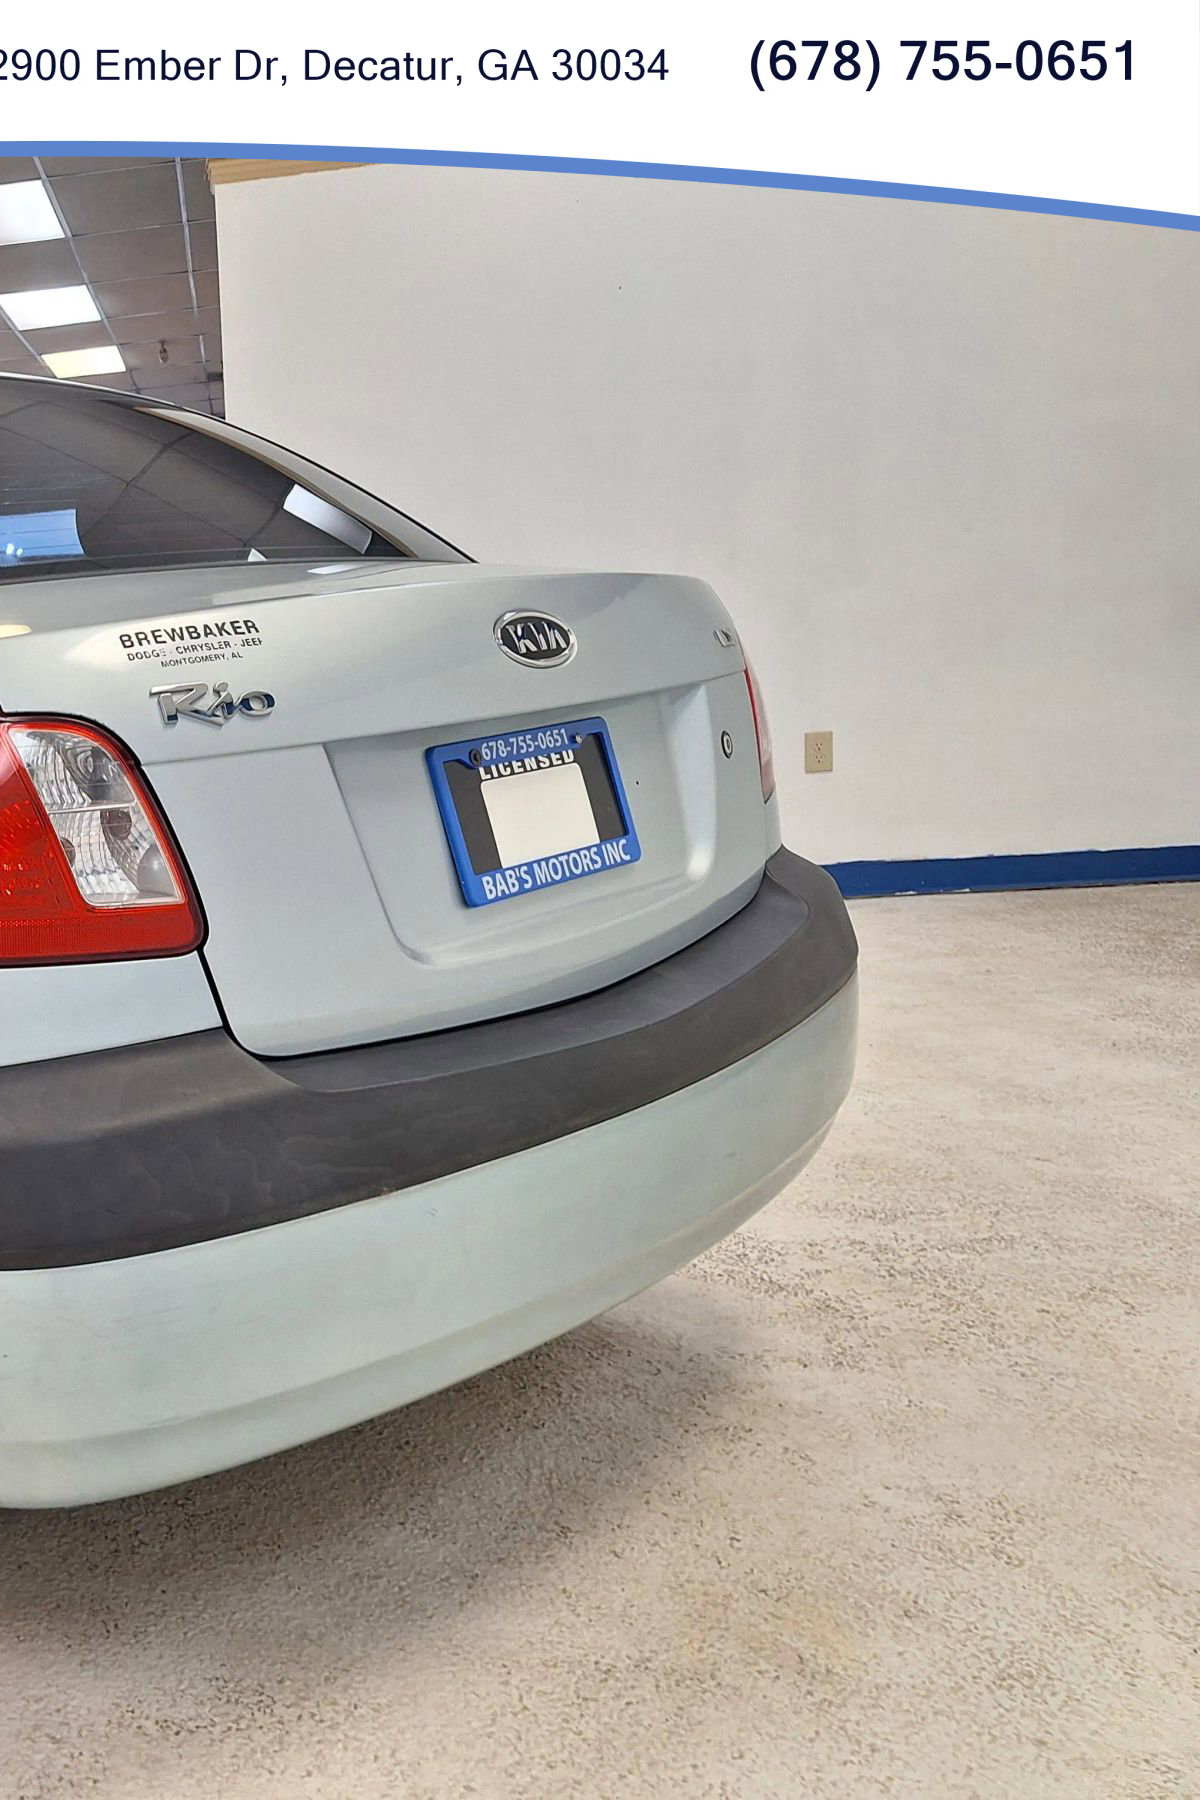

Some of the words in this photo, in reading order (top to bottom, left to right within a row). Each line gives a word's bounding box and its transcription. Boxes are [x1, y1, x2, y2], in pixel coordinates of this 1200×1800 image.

[119, 619, 260, 648] BREWBAKER
[175, 640, 232, 655] CHRYSLER
[505, 620, 568, 655] KIA
[160, 652, 229, 668] MONTGOMERY,
[231, 651, 244, 659] AL
[149, 681, 276, 727] Rio
[481, 728, 569, 761] 678-755-0651
[482, 866, 532, 900] BAB'S
[532, 847, 602, 886] MOTORS
[601, 839, 631, 866] INC
